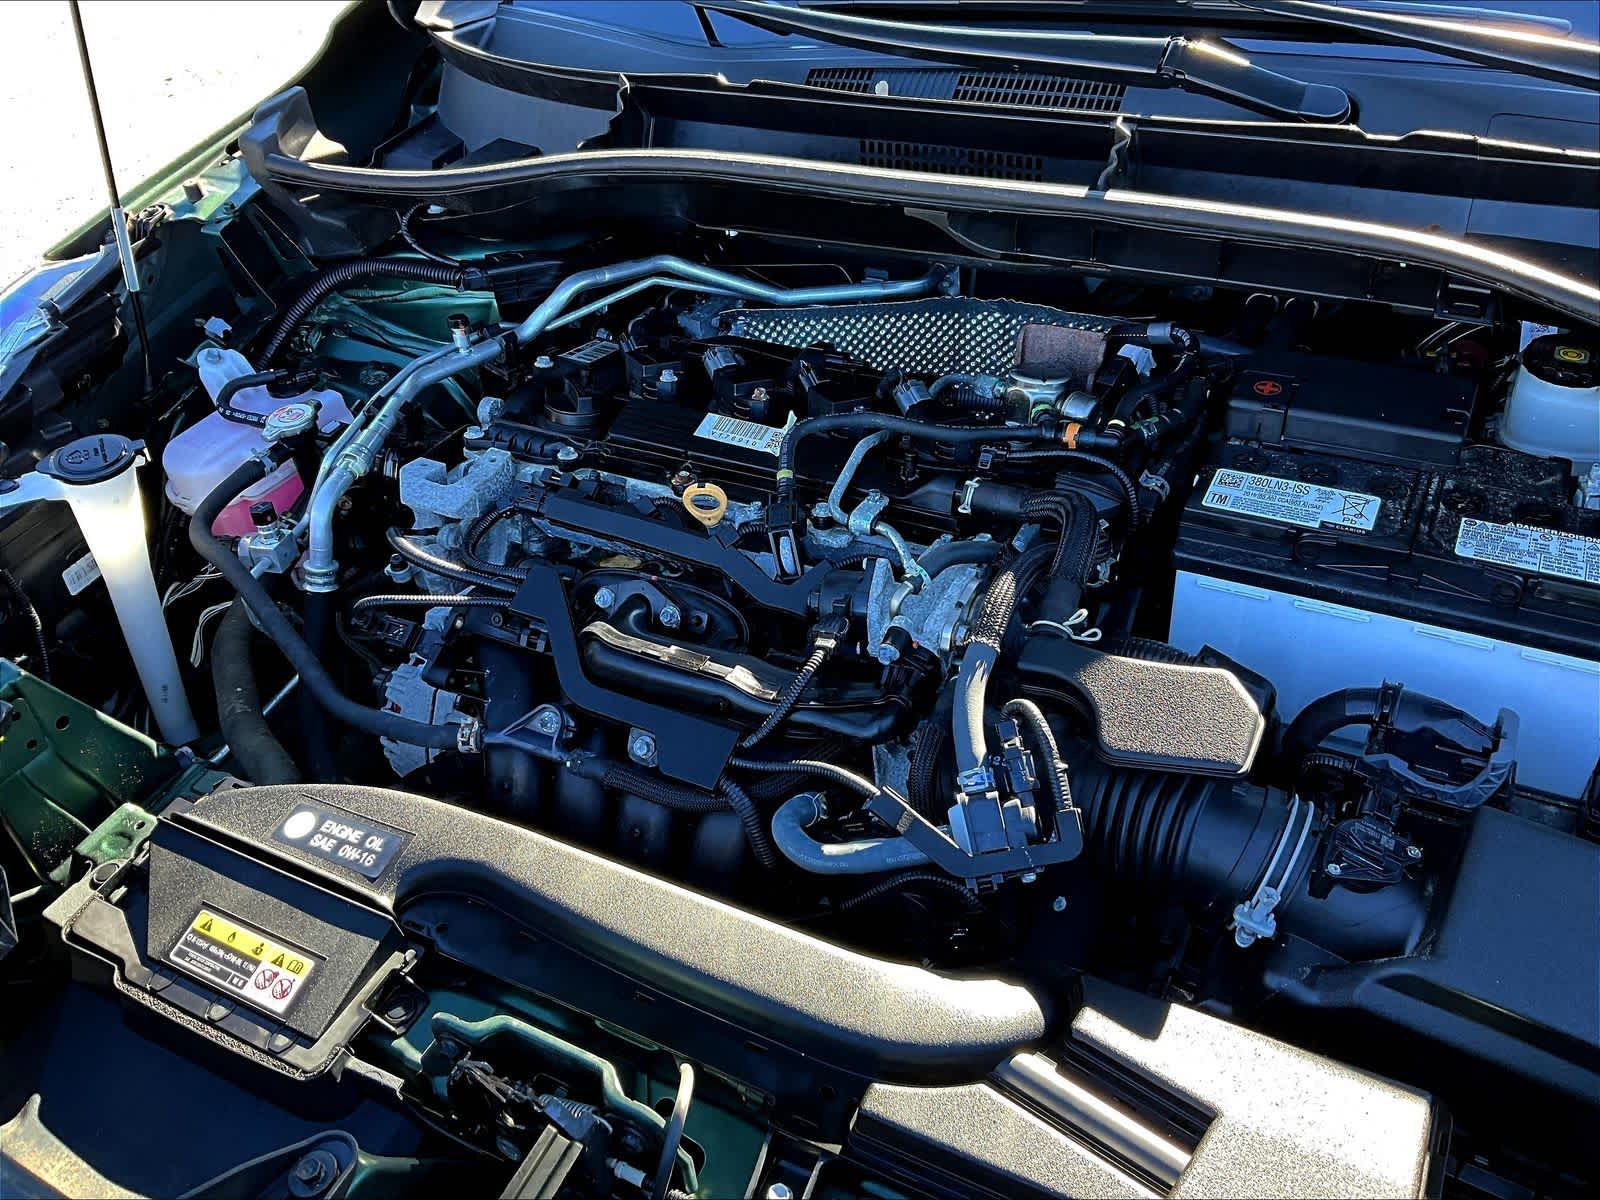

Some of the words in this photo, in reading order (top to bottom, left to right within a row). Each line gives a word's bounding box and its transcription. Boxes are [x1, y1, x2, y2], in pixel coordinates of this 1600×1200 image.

[1248, 476, 1311, 495] 380LN3-ISS
[1211, 493, 1228, 504] TM
[1342, 516, 1357, 525] Pb
[309, 833, 338, 853] SAE
[319, 819, 365, 844] ENGINE
[365, 835, 384, 852] OIL
